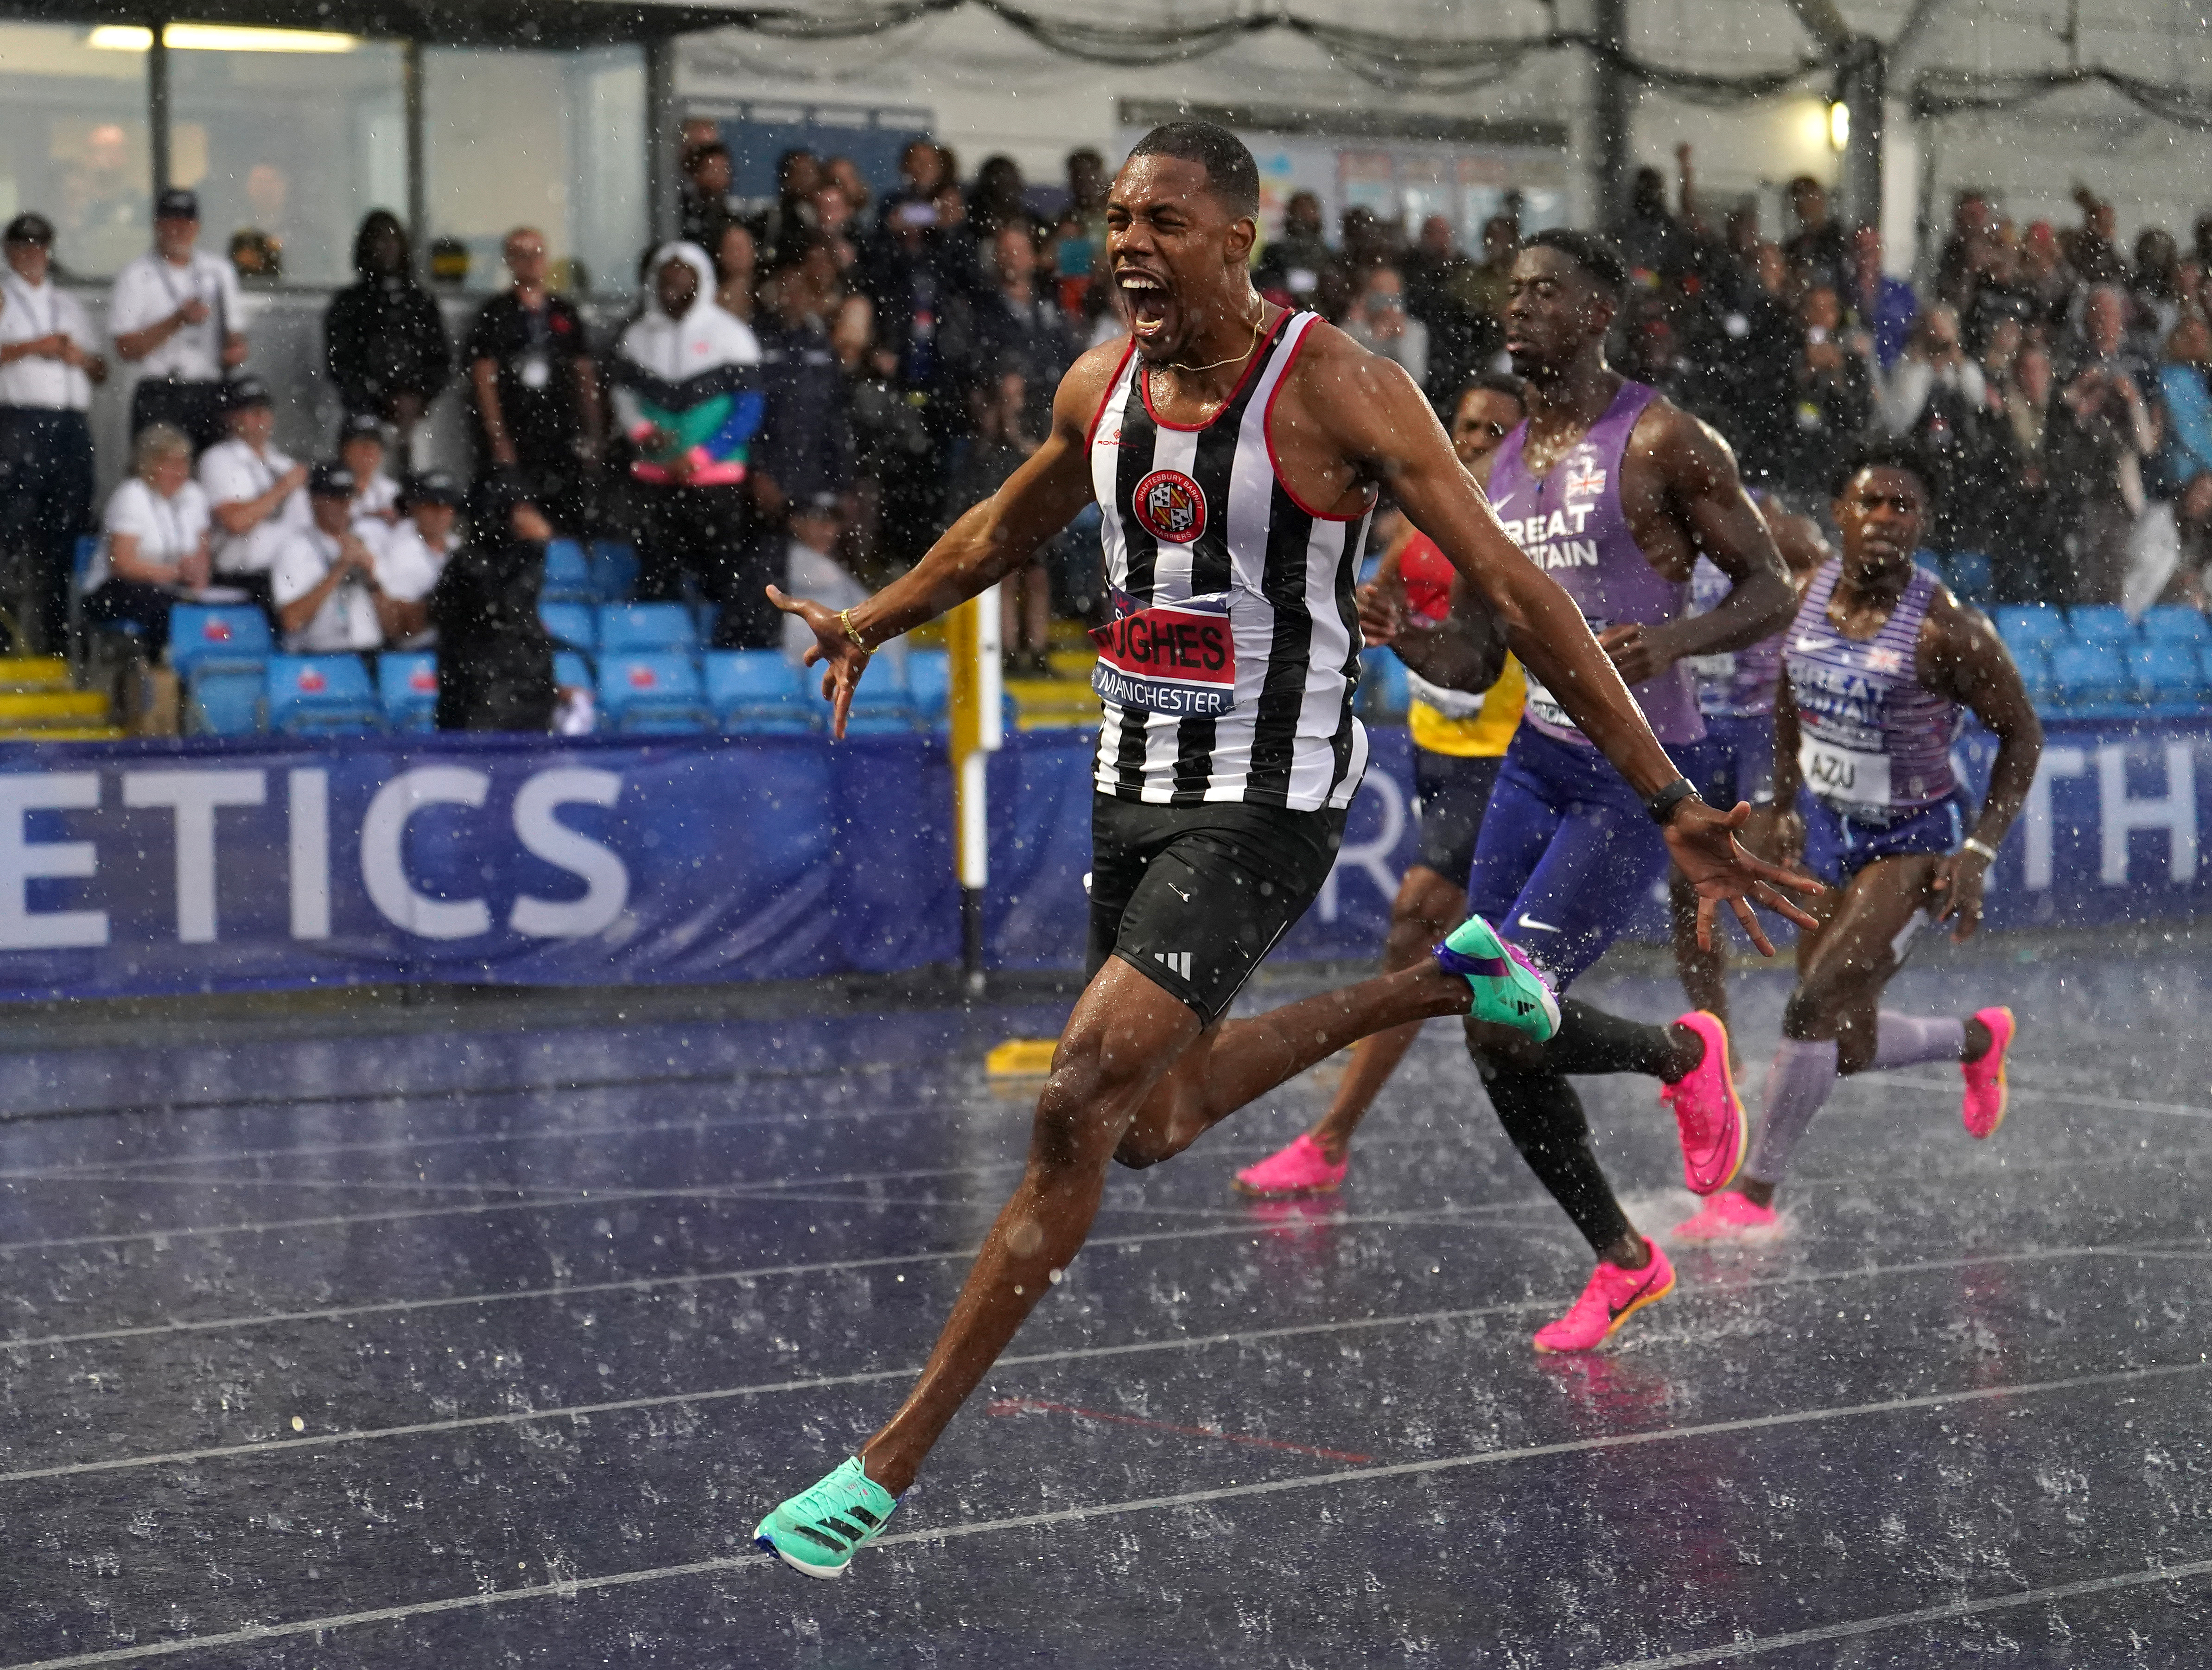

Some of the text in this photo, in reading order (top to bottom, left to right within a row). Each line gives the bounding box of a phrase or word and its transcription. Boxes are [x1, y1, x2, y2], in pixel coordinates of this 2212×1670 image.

[1138, 474, 1203, 510] SHAFTESBURY BARNET
[1154, 528, 1192, 541] HARRIERS
[1505, 503, 1595, 546] REAT
[1523, 539, 1598, 570] TAIN
[1098, 670, 1221, 713] MANCHESTER
[1810, 752, 1856, 790] AZU
